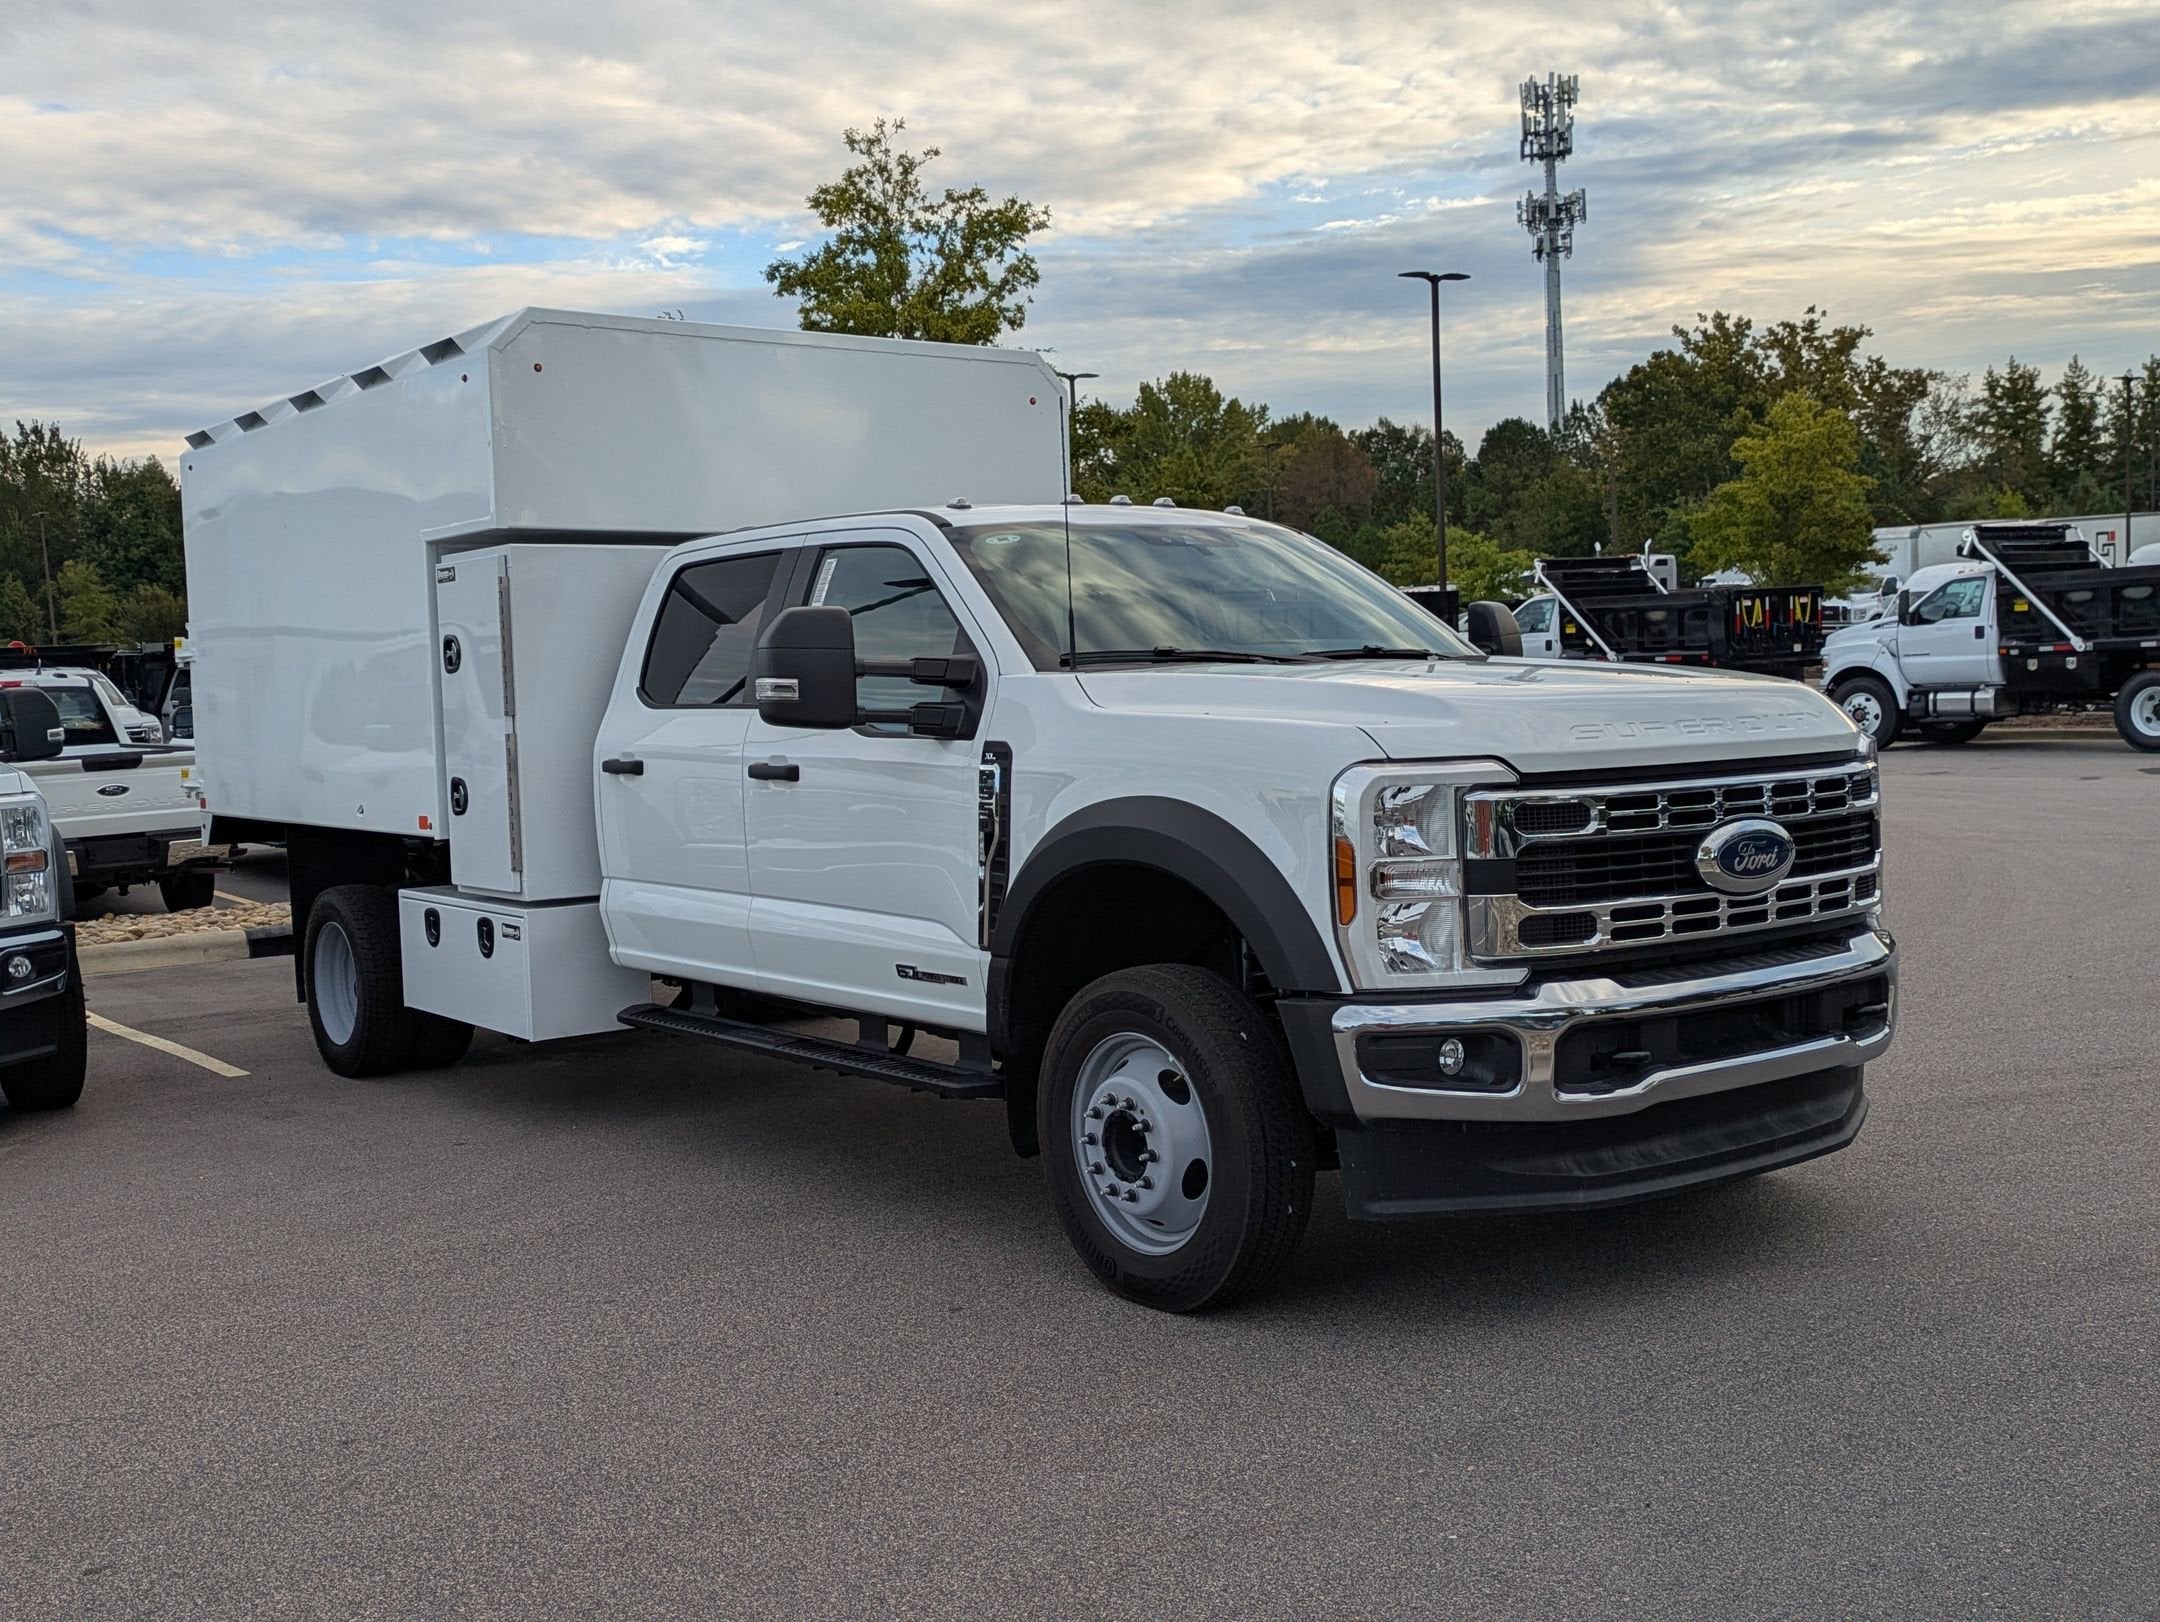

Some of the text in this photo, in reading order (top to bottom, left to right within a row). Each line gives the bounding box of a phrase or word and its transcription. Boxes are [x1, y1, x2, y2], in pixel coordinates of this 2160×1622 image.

[1569, 711, 1824, 741] SUPER DUTY
[984, 752, 996, 760] XL
[1734, 840, 1779, 872] Ford
